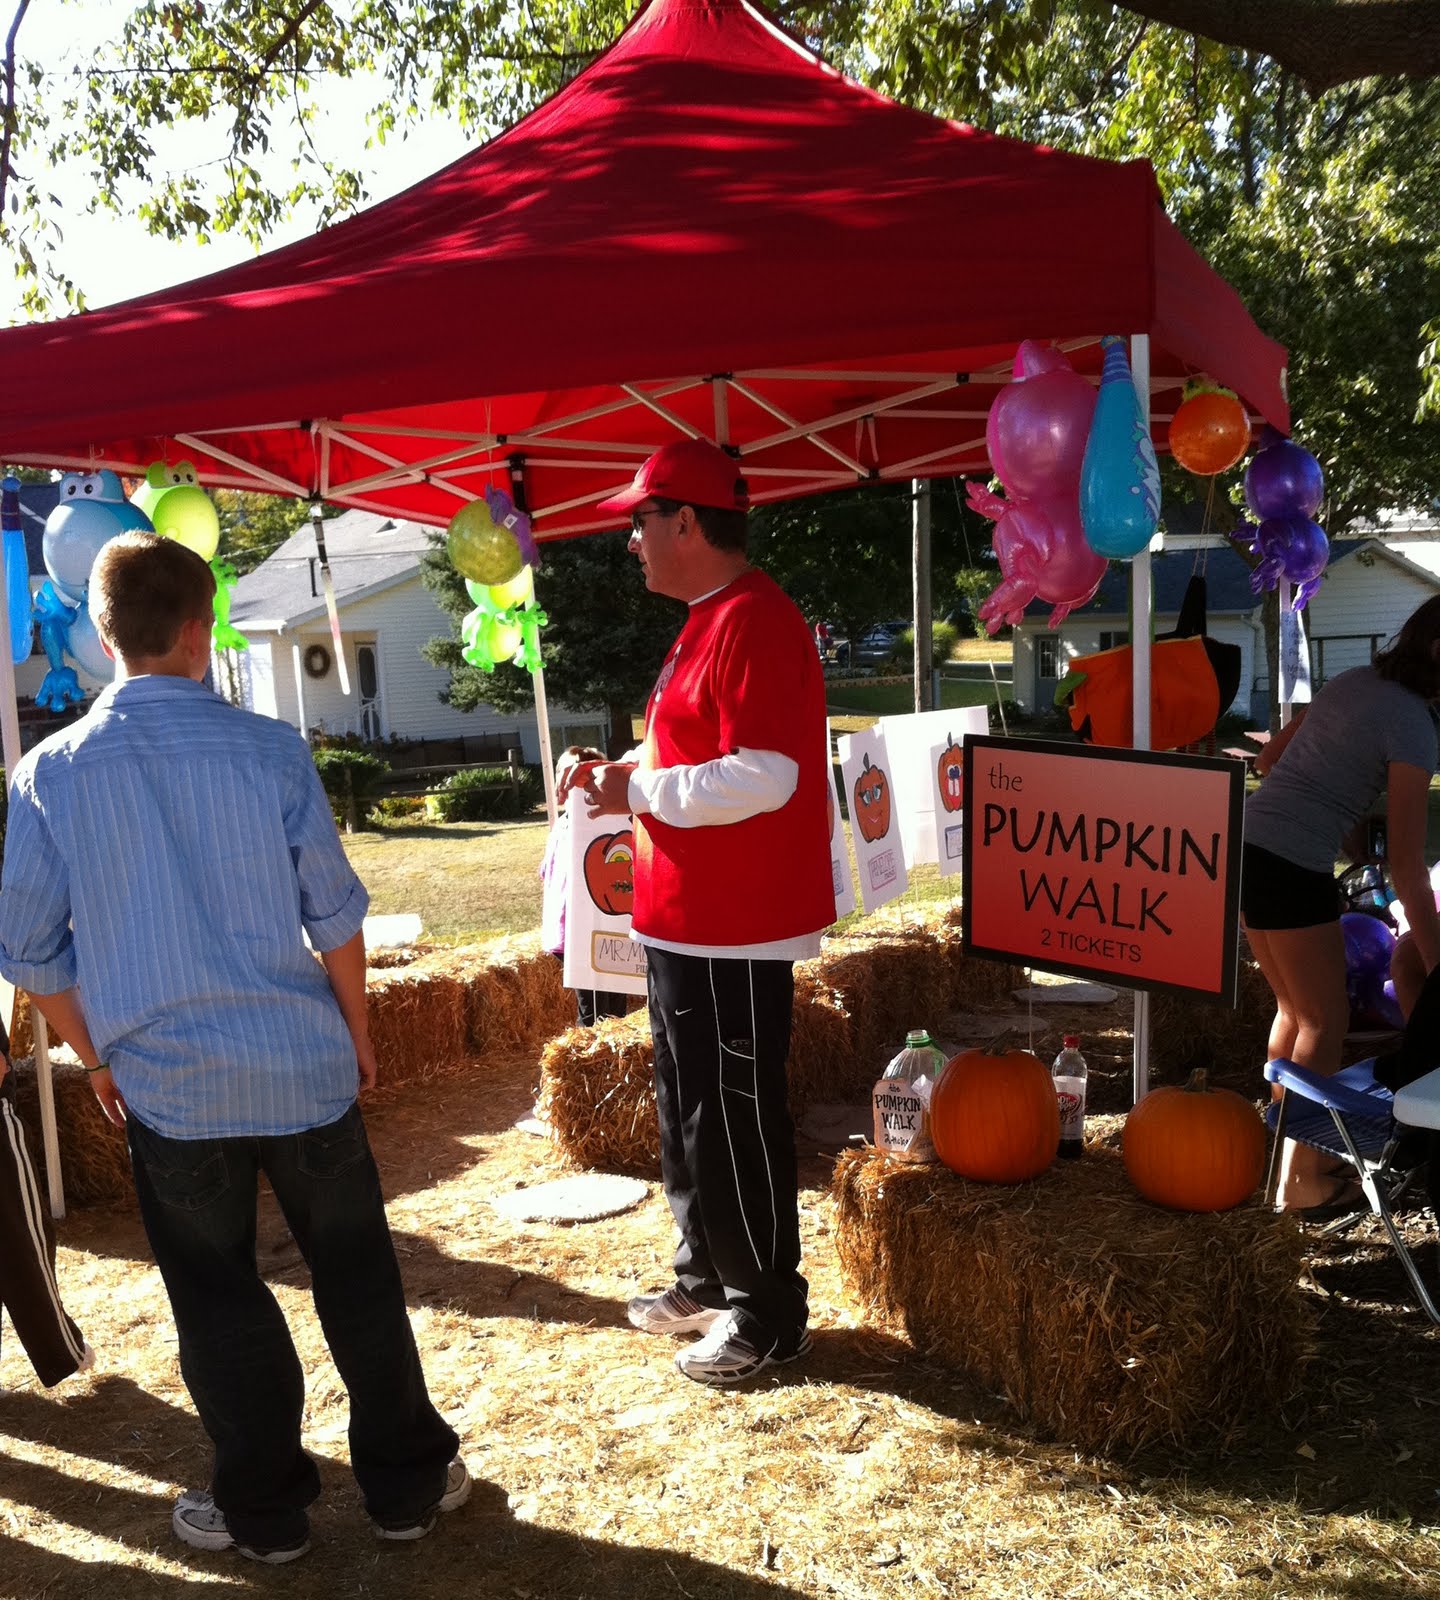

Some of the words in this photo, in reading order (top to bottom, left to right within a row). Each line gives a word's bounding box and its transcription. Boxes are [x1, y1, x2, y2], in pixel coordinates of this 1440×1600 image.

[987, 763, 1023, 792] the
[983, 803, 1221, 881] PUMPKIN
[1019, 869, 1173, 936] WALK
[1041, 929, 1052, 946] 2
[1057, 931, 1142, 963] TICKETS
[889, 1083, 901, 1092] the
[875, 1094, 921, 1112] PUMPKIN
[881, 1112, 916, 1130] WALK
